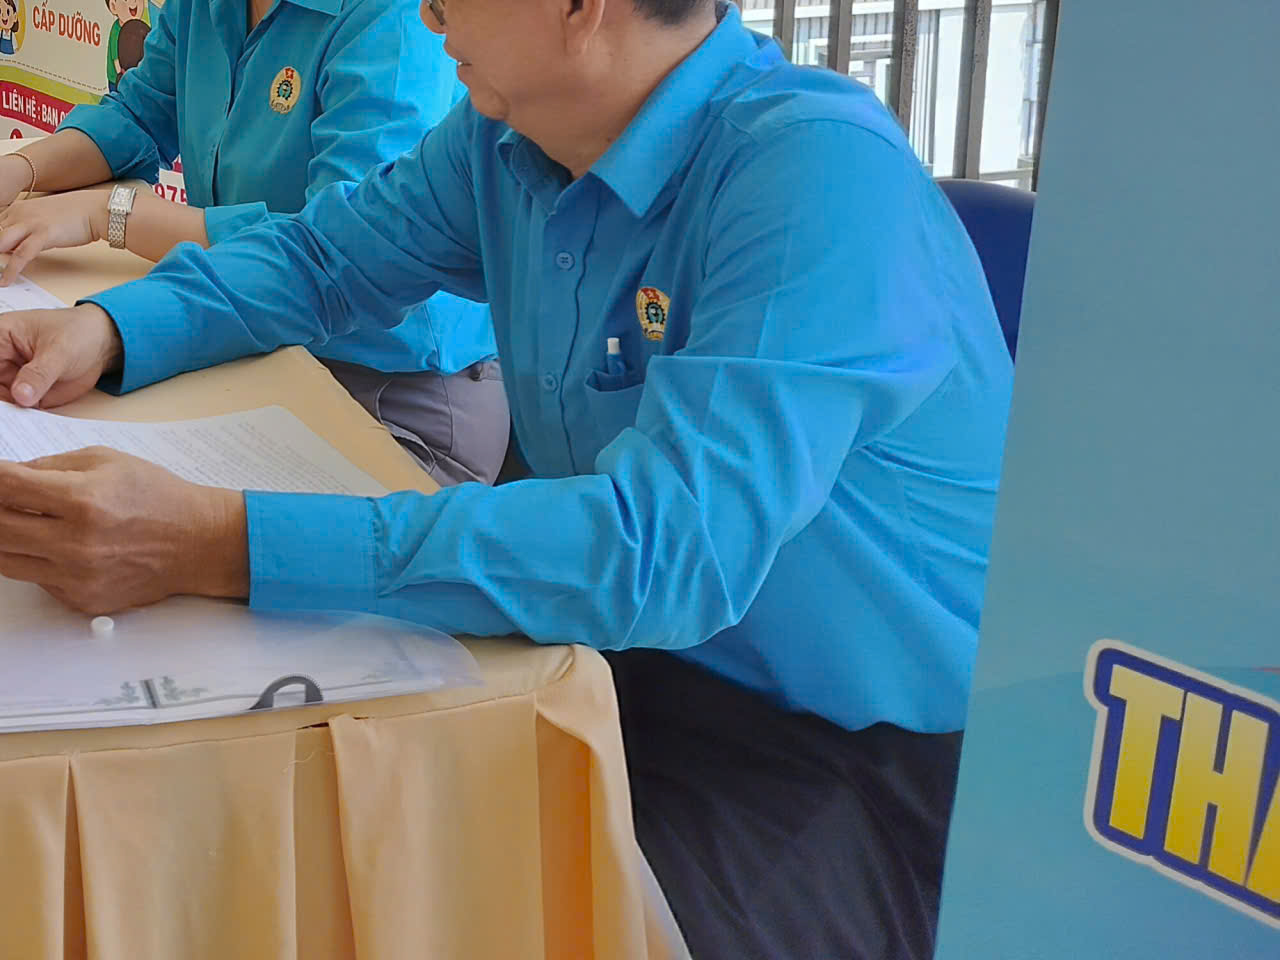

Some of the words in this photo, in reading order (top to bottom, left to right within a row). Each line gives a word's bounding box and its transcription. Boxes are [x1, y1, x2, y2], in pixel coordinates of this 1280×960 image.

[32, 0, 55, 33] CẤP
[58, 11, 101, 47] DƯỠNG
[2, 89, 24, 113] LIÊN
[41, 104, 58, 127] BAN
